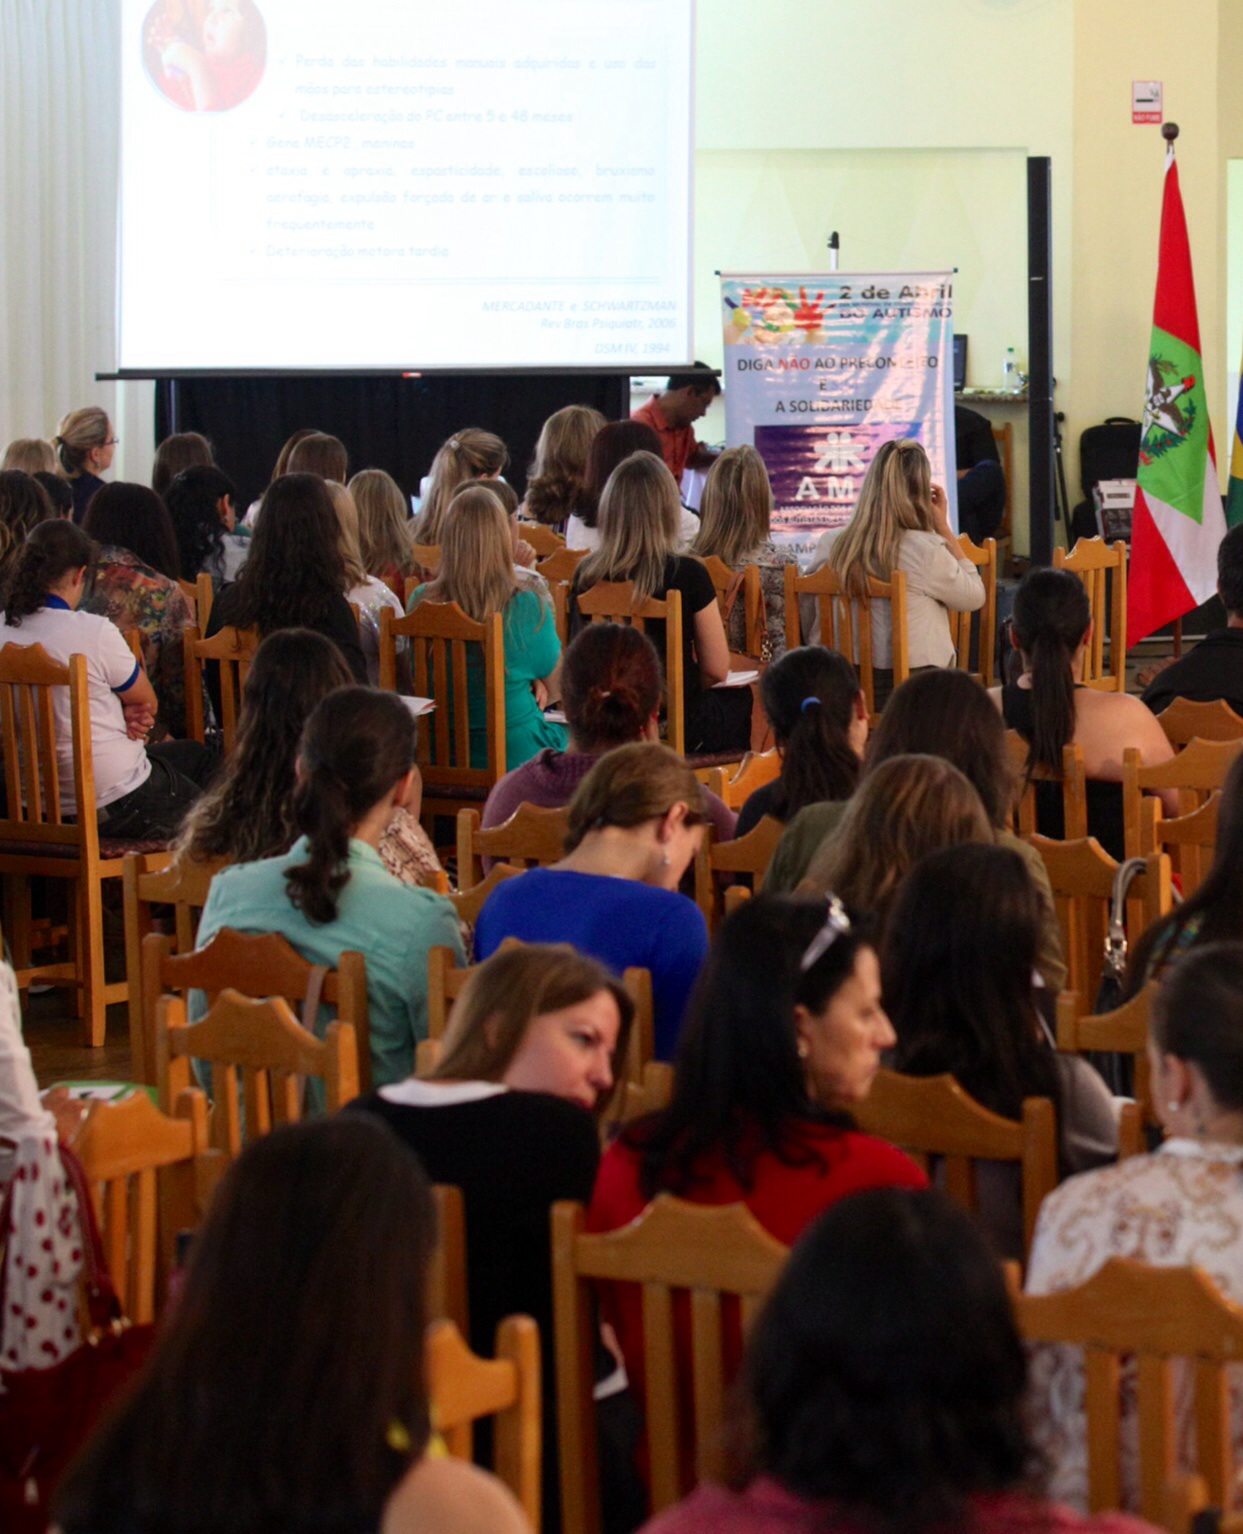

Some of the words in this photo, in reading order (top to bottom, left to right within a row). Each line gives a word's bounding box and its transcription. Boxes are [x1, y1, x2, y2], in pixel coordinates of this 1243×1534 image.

[373, 54, 447, 68] habilidades
[455, 59, 506, 69] manuais
[446, 110, 483, 122] entre
[531, 113, 573, 122] meses
[266, 136, 300, 149] Gene
[362, 137, 415, 149] meninas
[620, 192, 655, 203] muito
[839, 285, 852, 300] 2
[861, 285, 890, 300] de
[898, 284, 952, 300] Abril
[482, 300, 565, 312] MERCADANTE
[570, 303, 578, 312] e
[582, 300, 678, 312] SCHWARTZMAN
[872, 307, 952, 319] AUTISMO
[648, 317, 677, 329] 2006
[642, 342, 670, 354] 1994
[738, 358, 774, 371] DIGA
[778, 355, 810, 370] NÃO
[814, 358, 836, 369] AO
[819, 379, 827, 390] E
[775, 400, 785, 412] A
